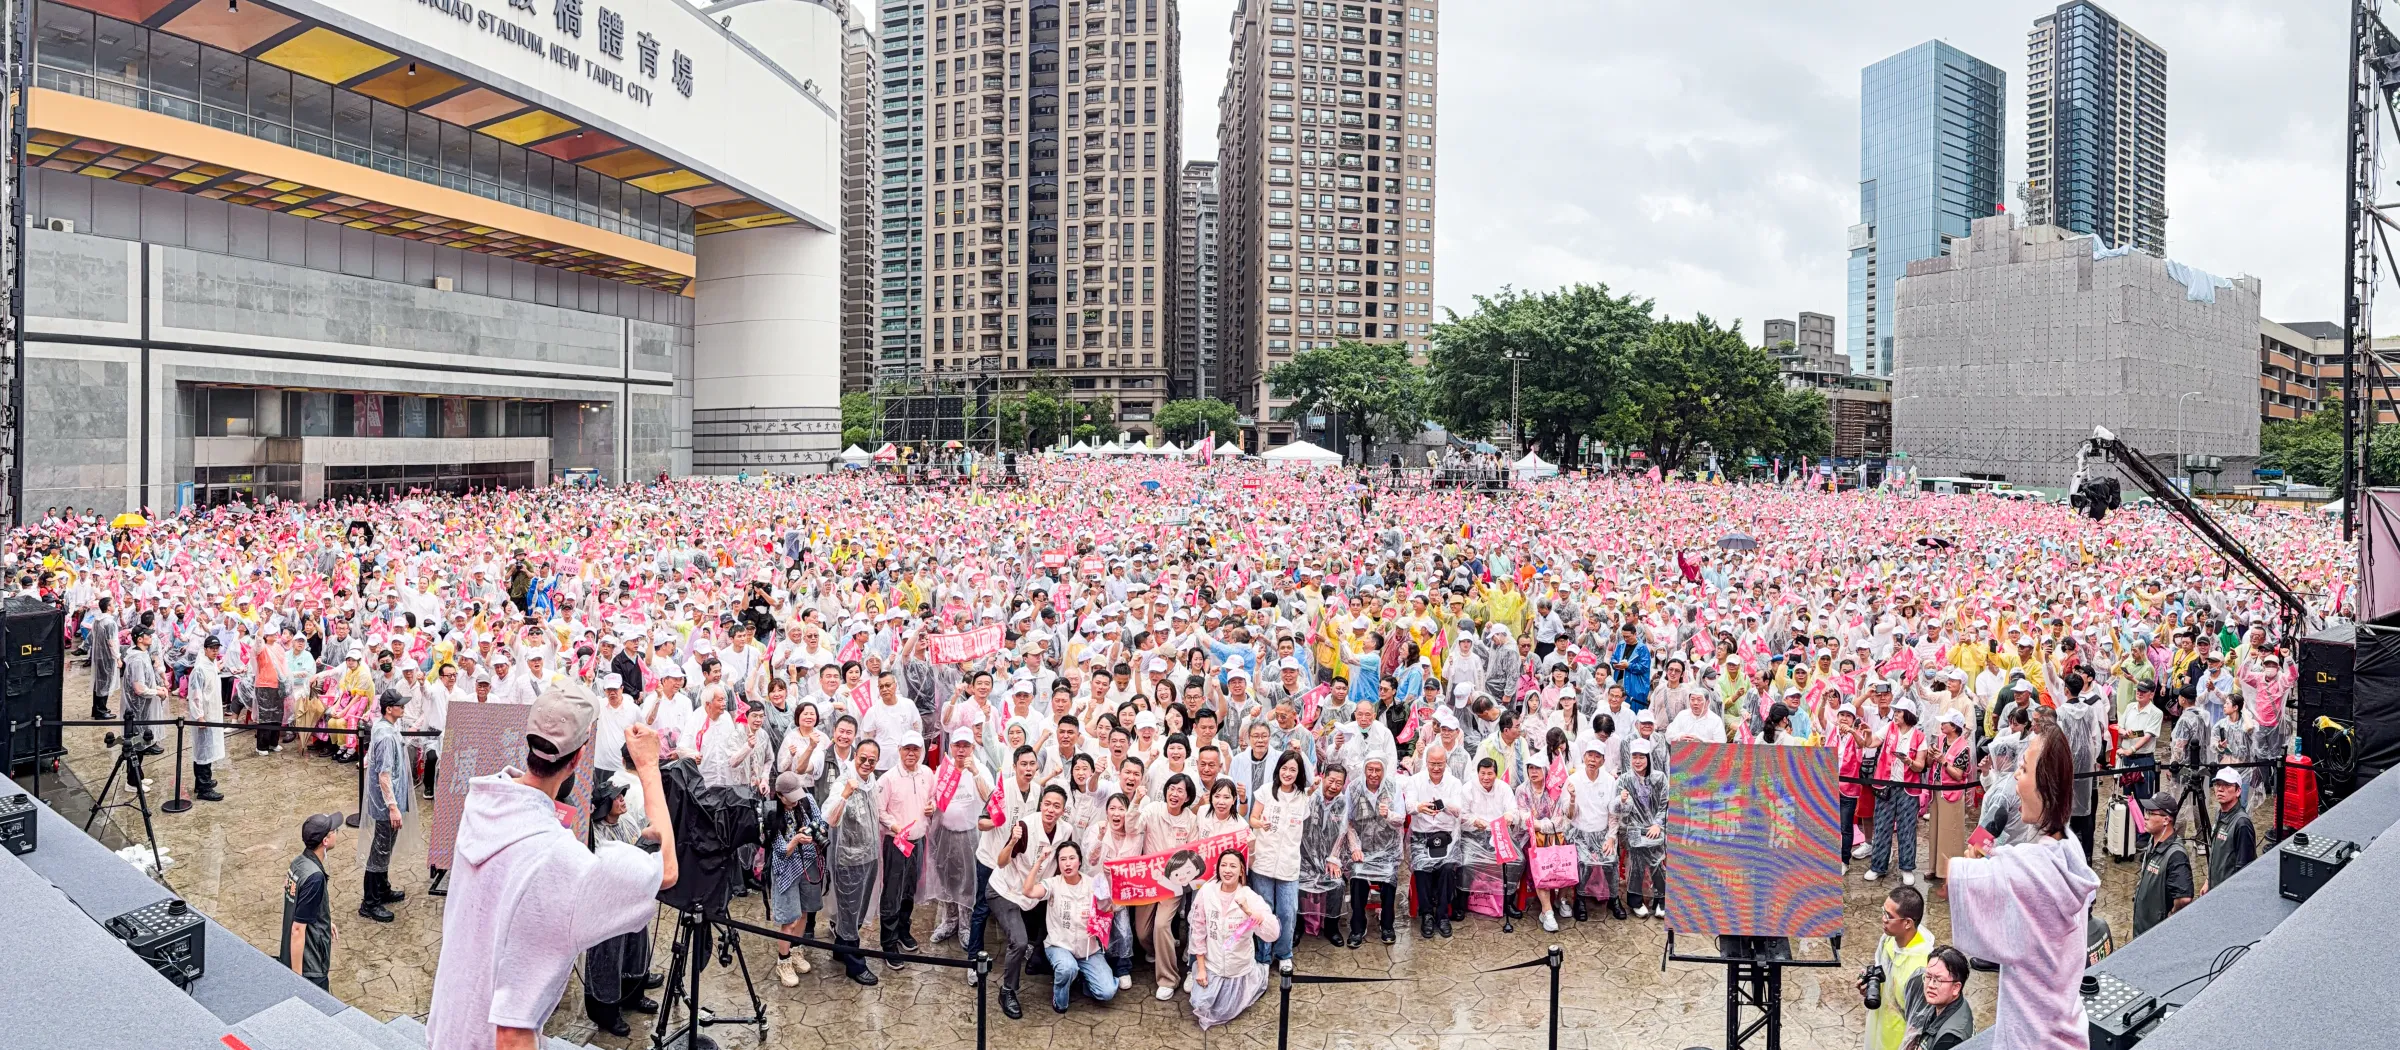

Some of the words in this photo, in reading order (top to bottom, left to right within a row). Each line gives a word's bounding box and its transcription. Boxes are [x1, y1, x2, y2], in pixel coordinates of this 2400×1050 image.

[478, 10, 546, 58] STADIUM,
[550, 42, 580, 71] NEW
[585, 59, 624, 93] TAIPEI
[627, 82, 653, 106] CITY
[508, 0, 694, 97] 橋體育場
[1198, 829, 1248, 859] 新市長
[1111, 857, 1165, 878] 新時代
[1120, 886, 1157, 900] 蘇巧慧
